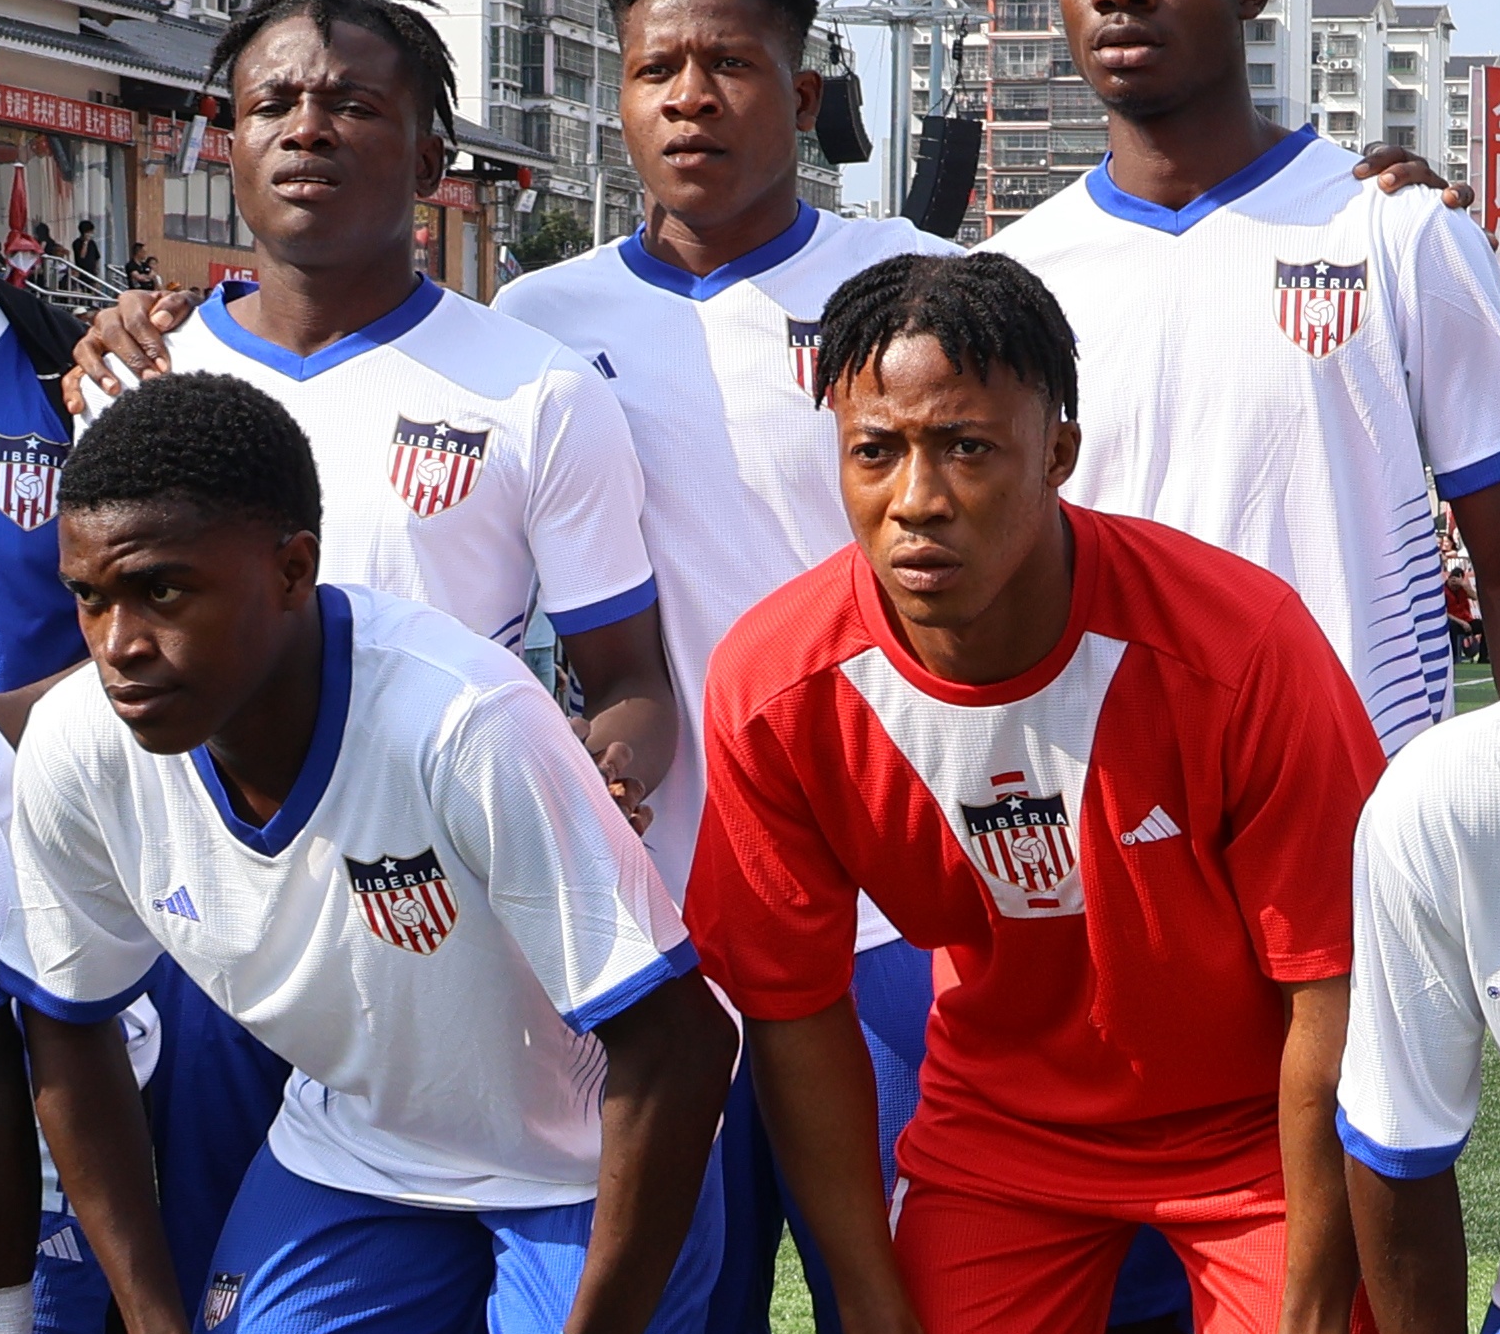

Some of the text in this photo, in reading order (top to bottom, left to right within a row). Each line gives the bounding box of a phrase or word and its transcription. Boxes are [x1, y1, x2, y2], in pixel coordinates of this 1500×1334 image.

[1277, 276, 1364, 289] LIBERIA
[395, 432, 481, 458] LIBERIA
[971, 812, 1067, 834] LIBERIA
[354, 867, 442, 892] LIBERIA
